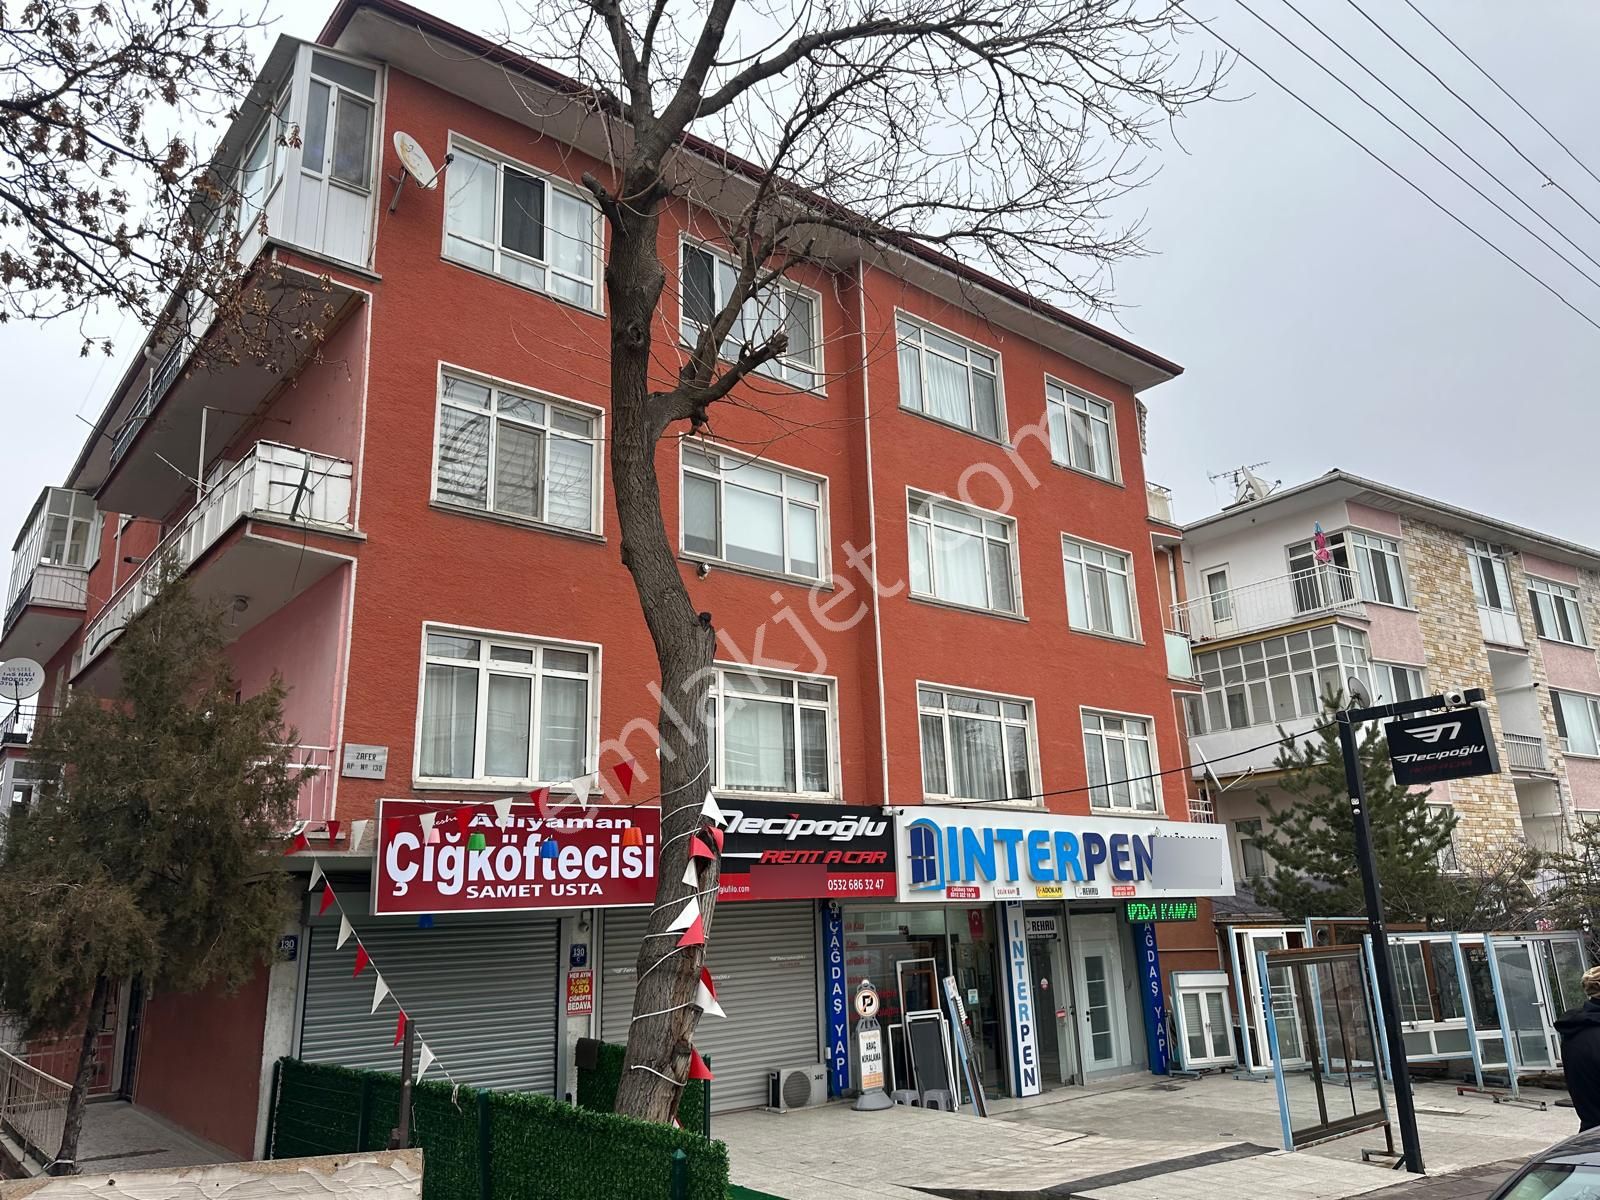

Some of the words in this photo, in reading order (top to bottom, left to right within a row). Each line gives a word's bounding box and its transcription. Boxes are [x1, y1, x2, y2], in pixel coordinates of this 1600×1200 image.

[356, 752, 377, 761] ZAFER
[1393, 744, 1485, 763] Necipoğlu
[372, 764, 383, 772] 130
[468, 813, 632, 833] Adıyaman
[715, 809, 888, 841] Necipoğlu
[760, 850, 824, 864] RENT
[946, 826, 1153, 882] INTERPEN
[386, 832, 654, 897] Çiğköftecisi
[466, 883, 543, 899] SAMET
[551, 882, 604, 896] USTA
[827, 879, 847, 891] 0532
[848, 879, 863, 891] 686
[865, 879, 874, 890] 32
[875, 879, 884, 890] 47
[280, 939, 295, 950] 130
[573, 947, 585, 957] 130
[1144, 923, 1159, 997] AĞDAŞ
[570, 985, 590, 994] %50
[567, 1002, 591, 1011] BEDAVA
[1013, 919, 1036, 1087] INTERPEN
[1154, 1006, 1166, 1068] YAPI
[834, 1024, 846, 1087] YAPI
